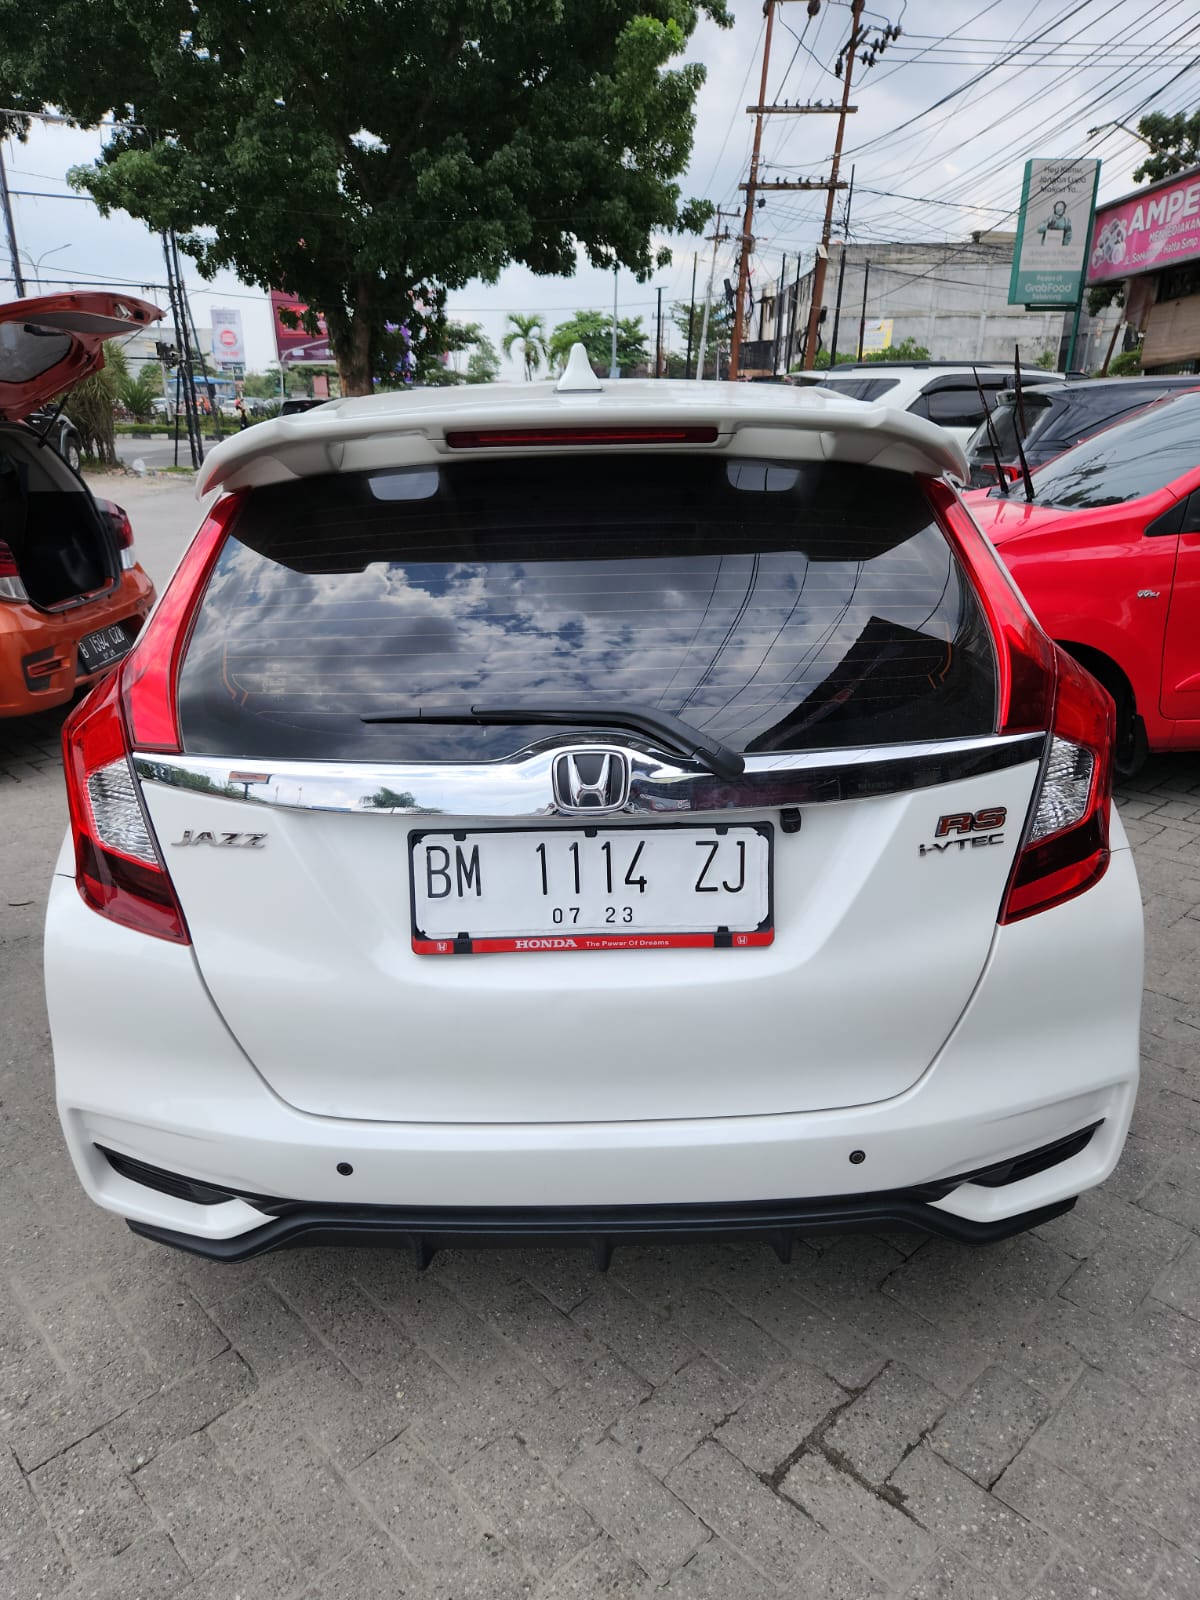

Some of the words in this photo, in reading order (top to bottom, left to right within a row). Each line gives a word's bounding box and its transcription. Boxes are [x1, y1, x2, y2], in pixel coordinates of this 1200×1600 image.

[1128, 182, 1200, 235] AMPE
[1025, 282, 1072, 293] GrabFood
[79, 642, 90, 659] B
[935, 807, 1007, 838] RS
[171, 830, 268, 848] JAZZ
[919, 833, 1004, 857] i-VTEC
[426, 844, 482, 898] BM
[536, 840, 648, 895] 1114
[695, 841, 745, 893] ZJ
[552, 907, 581, 924] 07
[605, 906, 634, 923] 23
[515, 939, 578, 949] HONDA
